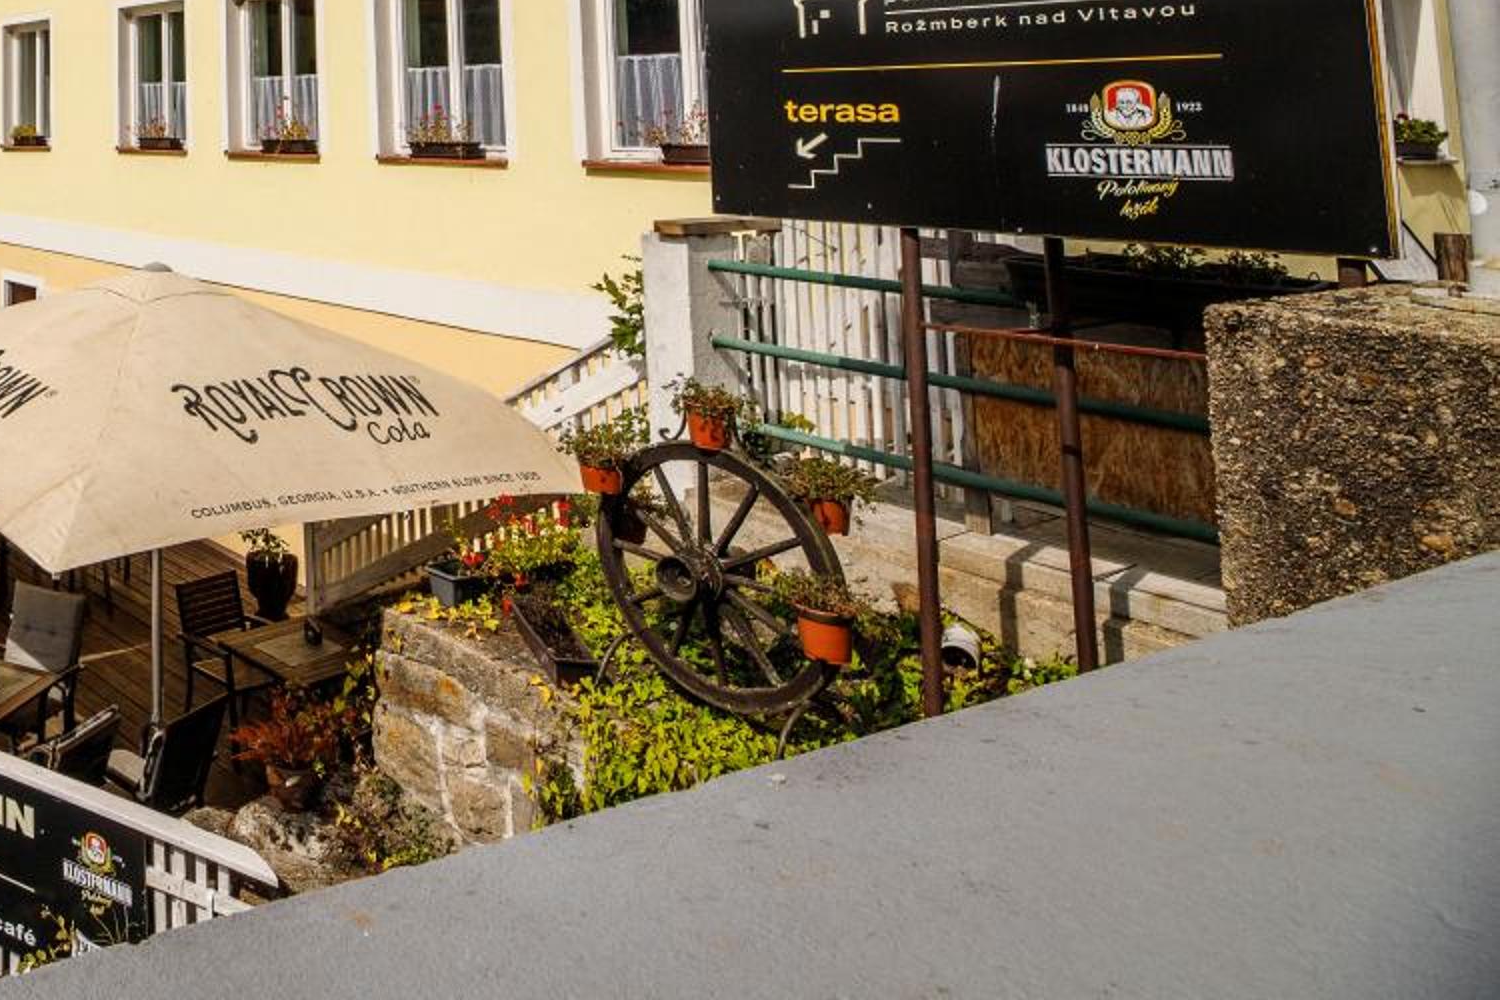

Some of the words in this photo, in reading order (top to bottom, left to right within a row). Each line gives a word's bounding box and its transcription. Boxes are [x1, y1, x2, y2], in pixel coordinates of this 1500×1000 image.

[885, 14, 1008, 33] Rožmberk
[1018, 10, 1066, 25] nad
[1077, 3, 1196, 22] Vltavou
[784, 100, 900, 123] terasa
[1045, 147, 1235, 177] KLOSTERMANN
[171, 370, 308, 444] ROYAL
[289, 367, 440, 432] CROWN
[367, 417, 431, 445] Cola
